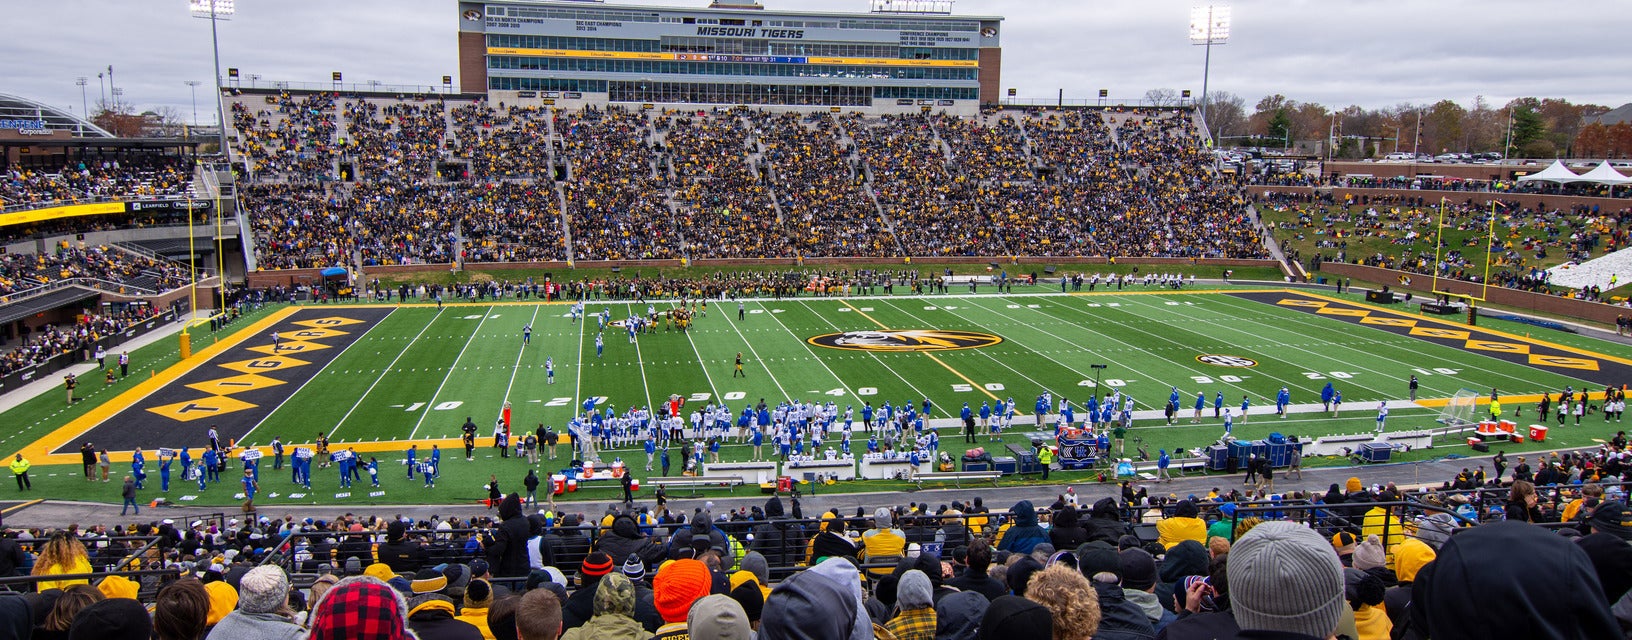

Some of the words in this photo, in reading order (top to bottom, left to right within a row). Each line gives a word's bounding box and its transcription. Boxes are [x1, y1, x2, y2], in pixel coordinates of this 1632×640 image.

[697, 27, 756, 37] MISSOURI
[761, 29, 804, 38] TIGERS
[0, 120, 46, 129] ENTENE
[1077, 379, 1126, 387] 40
[1190, 375, 1243, 383] 30
[825, 387, 878, 396] 40
[951, 383, 1005, 392] 50
[544, 396, 608, 406] 20
[687, 392, 746, 401] 30
[404, 401, 464, 411] 10
[1075, 446, 1086, 457] UK
